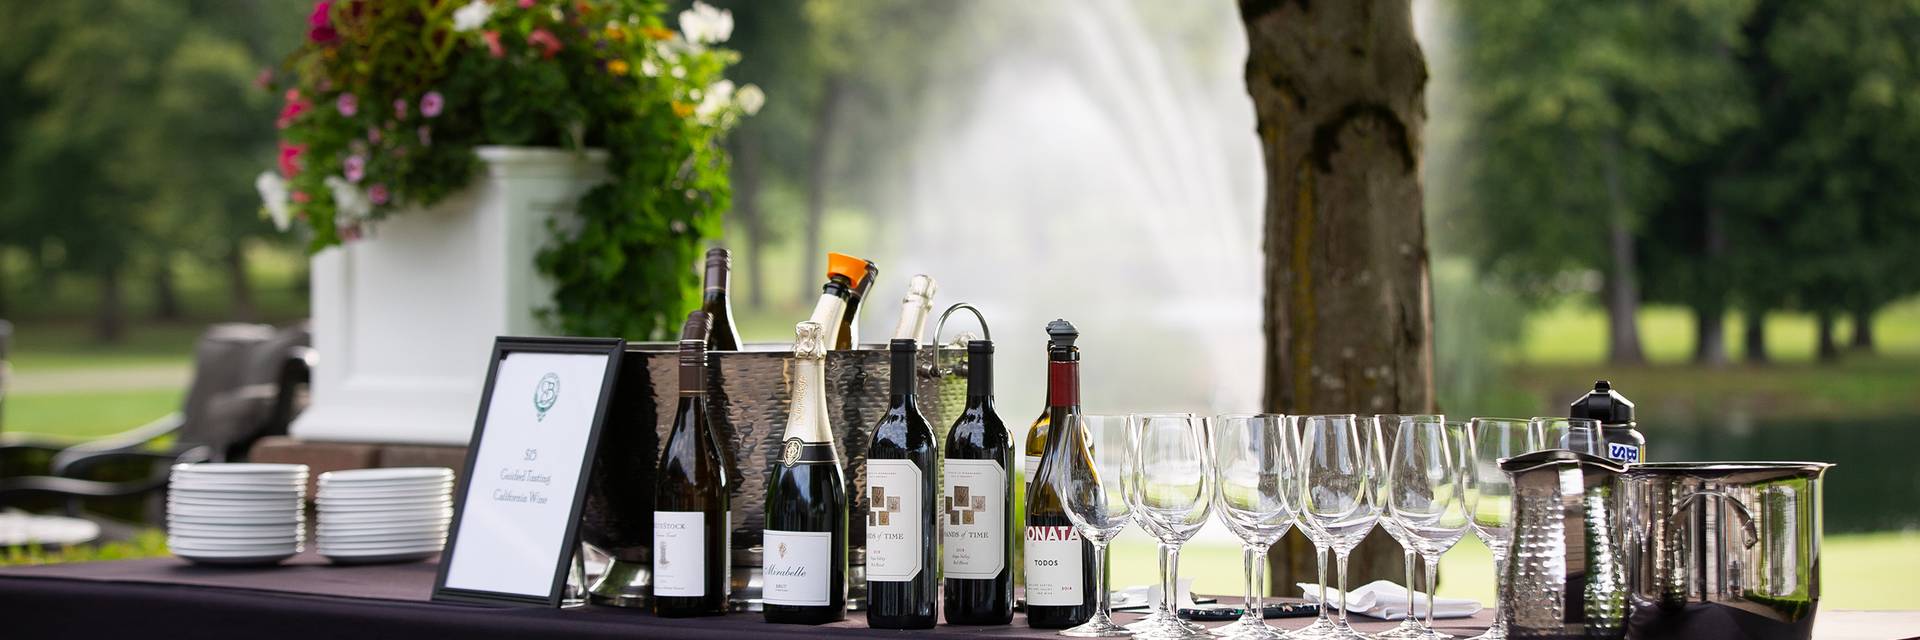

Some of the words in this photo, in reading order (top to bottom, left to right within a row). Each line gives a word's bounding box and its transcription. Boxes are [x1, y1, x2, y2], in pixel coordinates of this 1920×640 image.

[494, 488, 527, 503] California
[529, 490, 548, 504] Wine
[765, 563, 806, 578] Mirabelle
